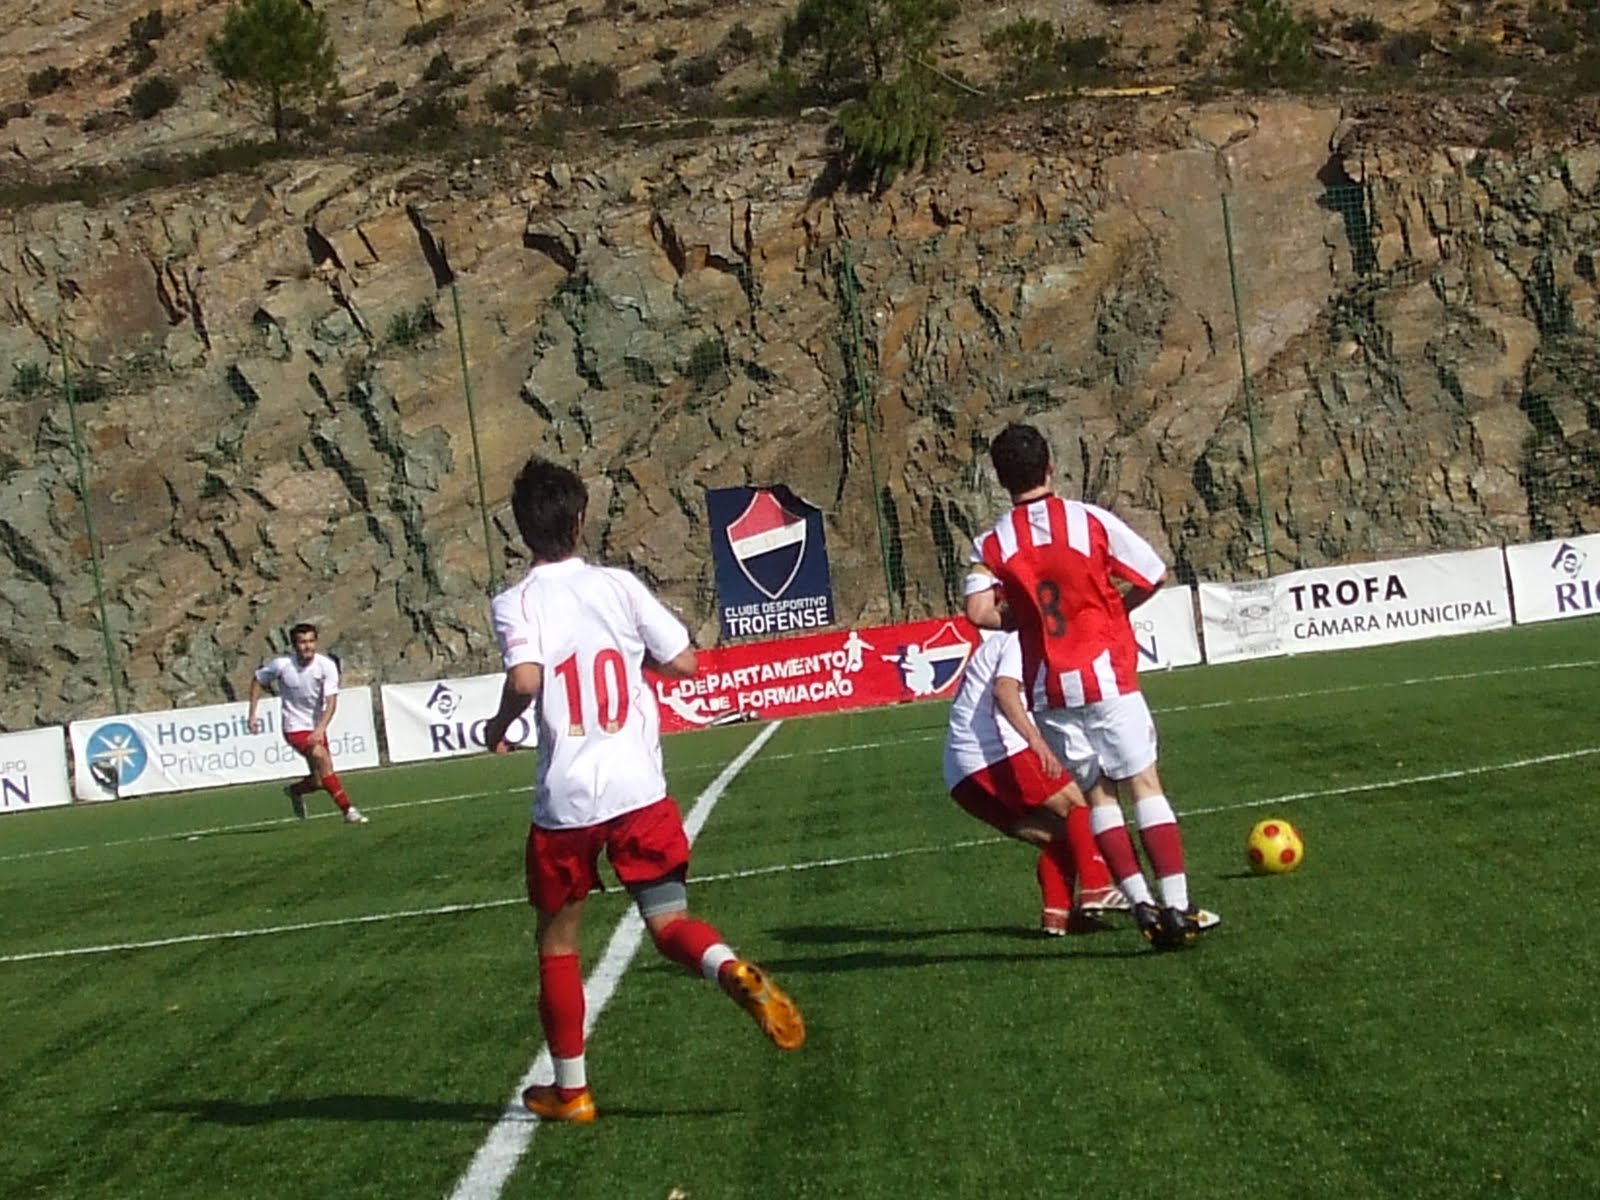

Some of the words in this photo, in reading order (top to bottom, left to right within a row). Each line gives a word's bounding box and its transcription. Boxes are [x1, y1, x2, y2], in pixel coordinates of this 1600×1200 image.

[725, 604, 760, 618] CLUBE
[762, 596, 827, 613] DESPORTIVO
[1289, 574, 1408, 611] TROFA
[1555, 580, 1600, 613] RI
[726, 607, 829, 636] TROFENSE
[1294, 615, 1380, 639] CÂMARA
[1386, 600, 1496, 629] MUNICIPAL
[554, 648, 629, 737] 10
[679, 651, 847, 698] DEPARTAMENTO
[157, 711, 274, 745] Hospital
[160, 745, 256, 777] Privado
[264, 741, 296, 764] da
